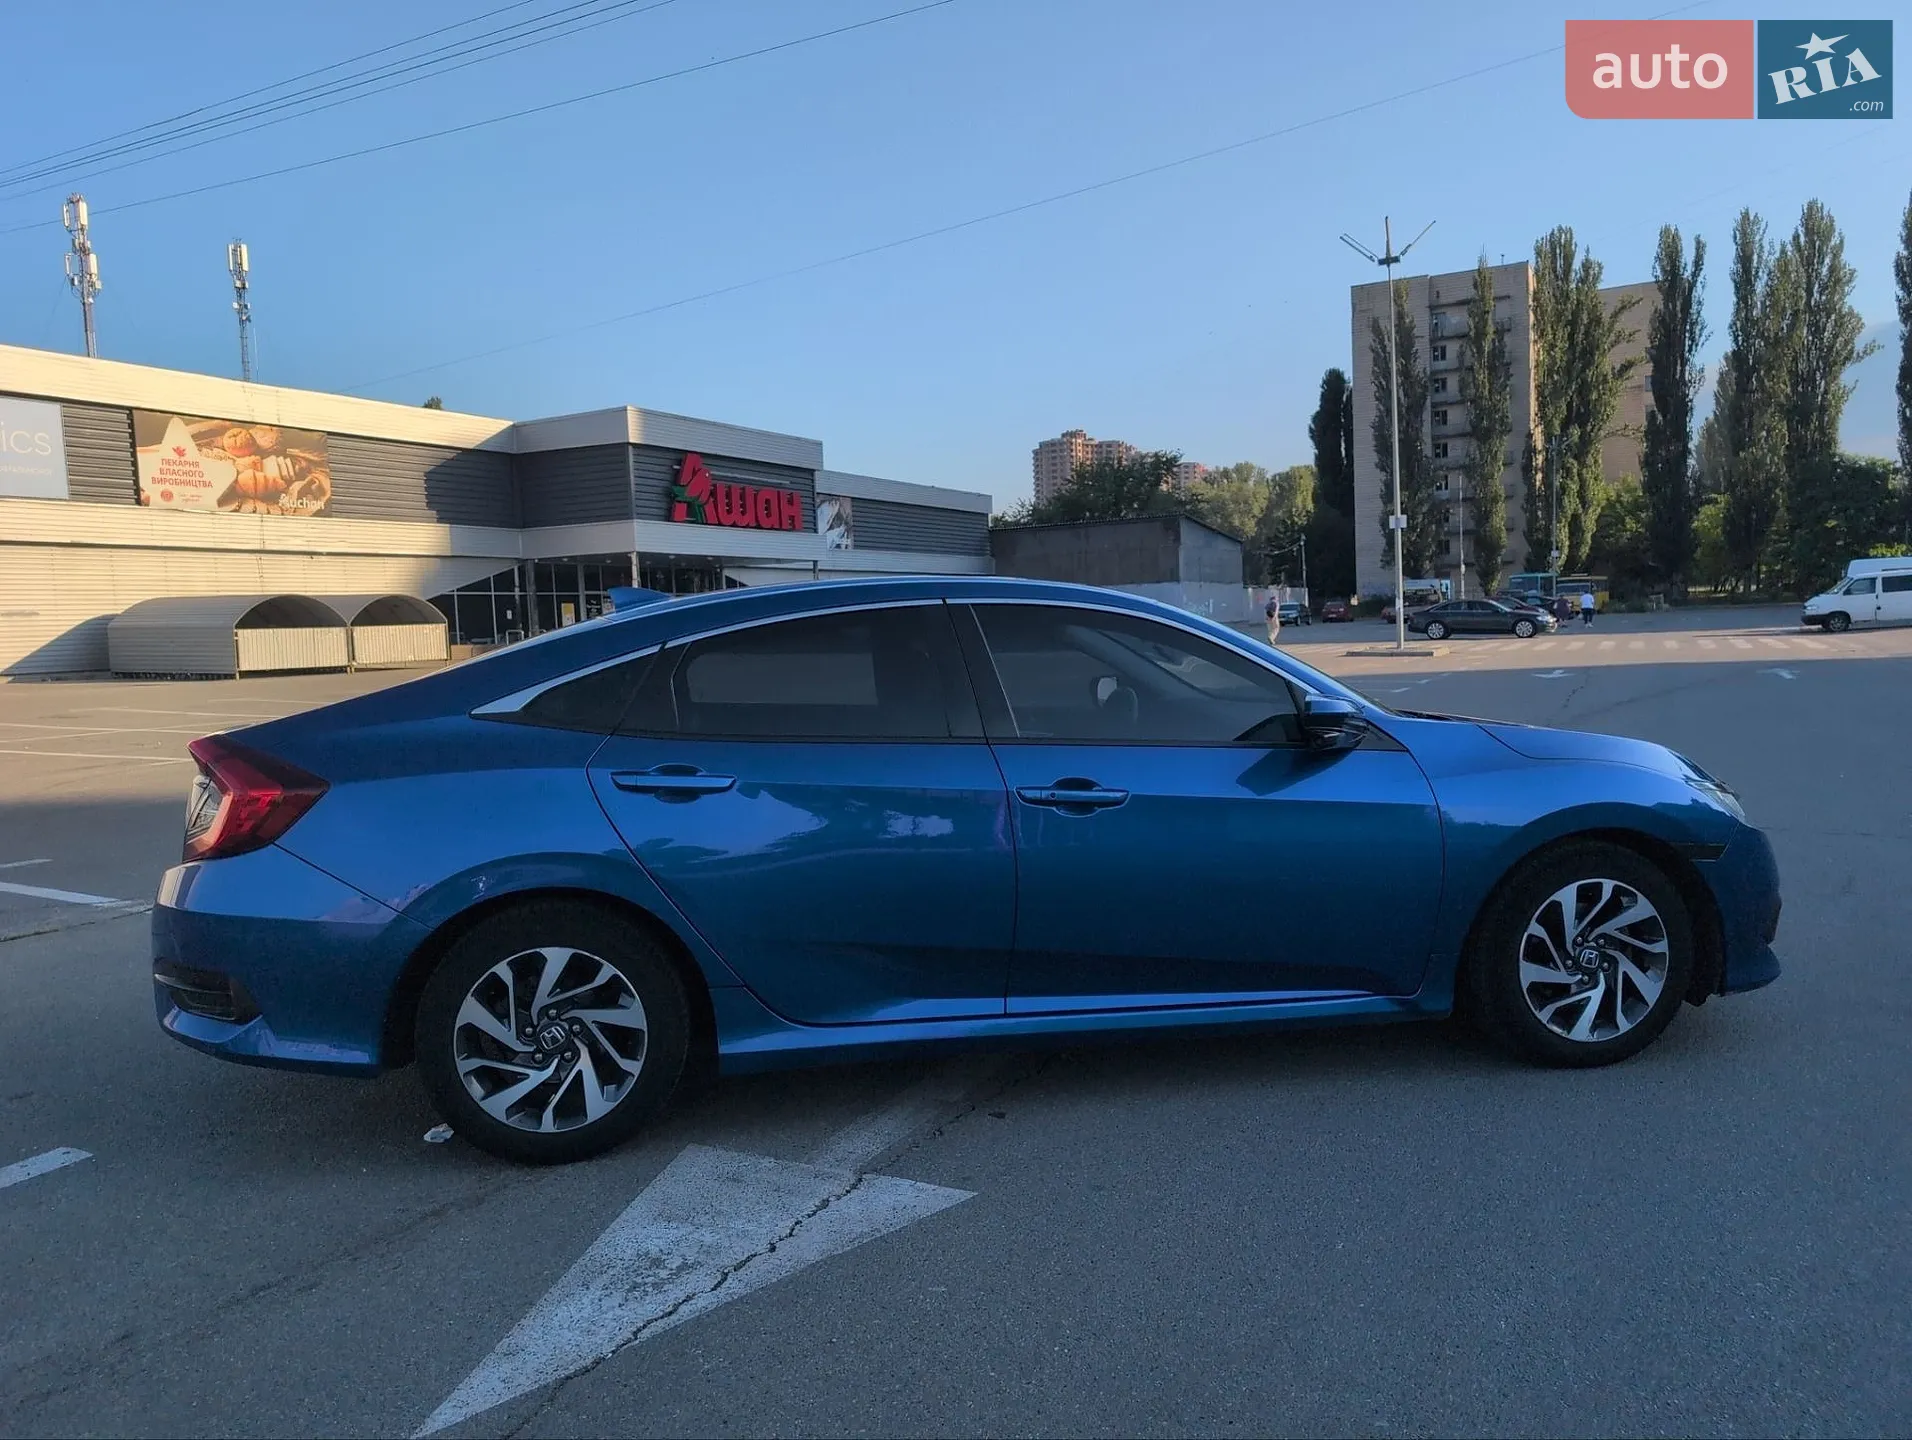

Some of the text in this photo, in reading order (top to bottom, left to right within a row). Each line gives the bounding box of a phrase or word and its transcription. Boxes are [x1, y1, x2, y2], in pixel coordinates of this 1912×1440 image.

[160, 457, 200, 469] ПЕКАРНЯ
[159, 467, 205, 479] ВЛАСНОГО
[151, 476, 213, 489] ВИРОБНИЦТВА
[278, 493, 326, 510] Auchan
